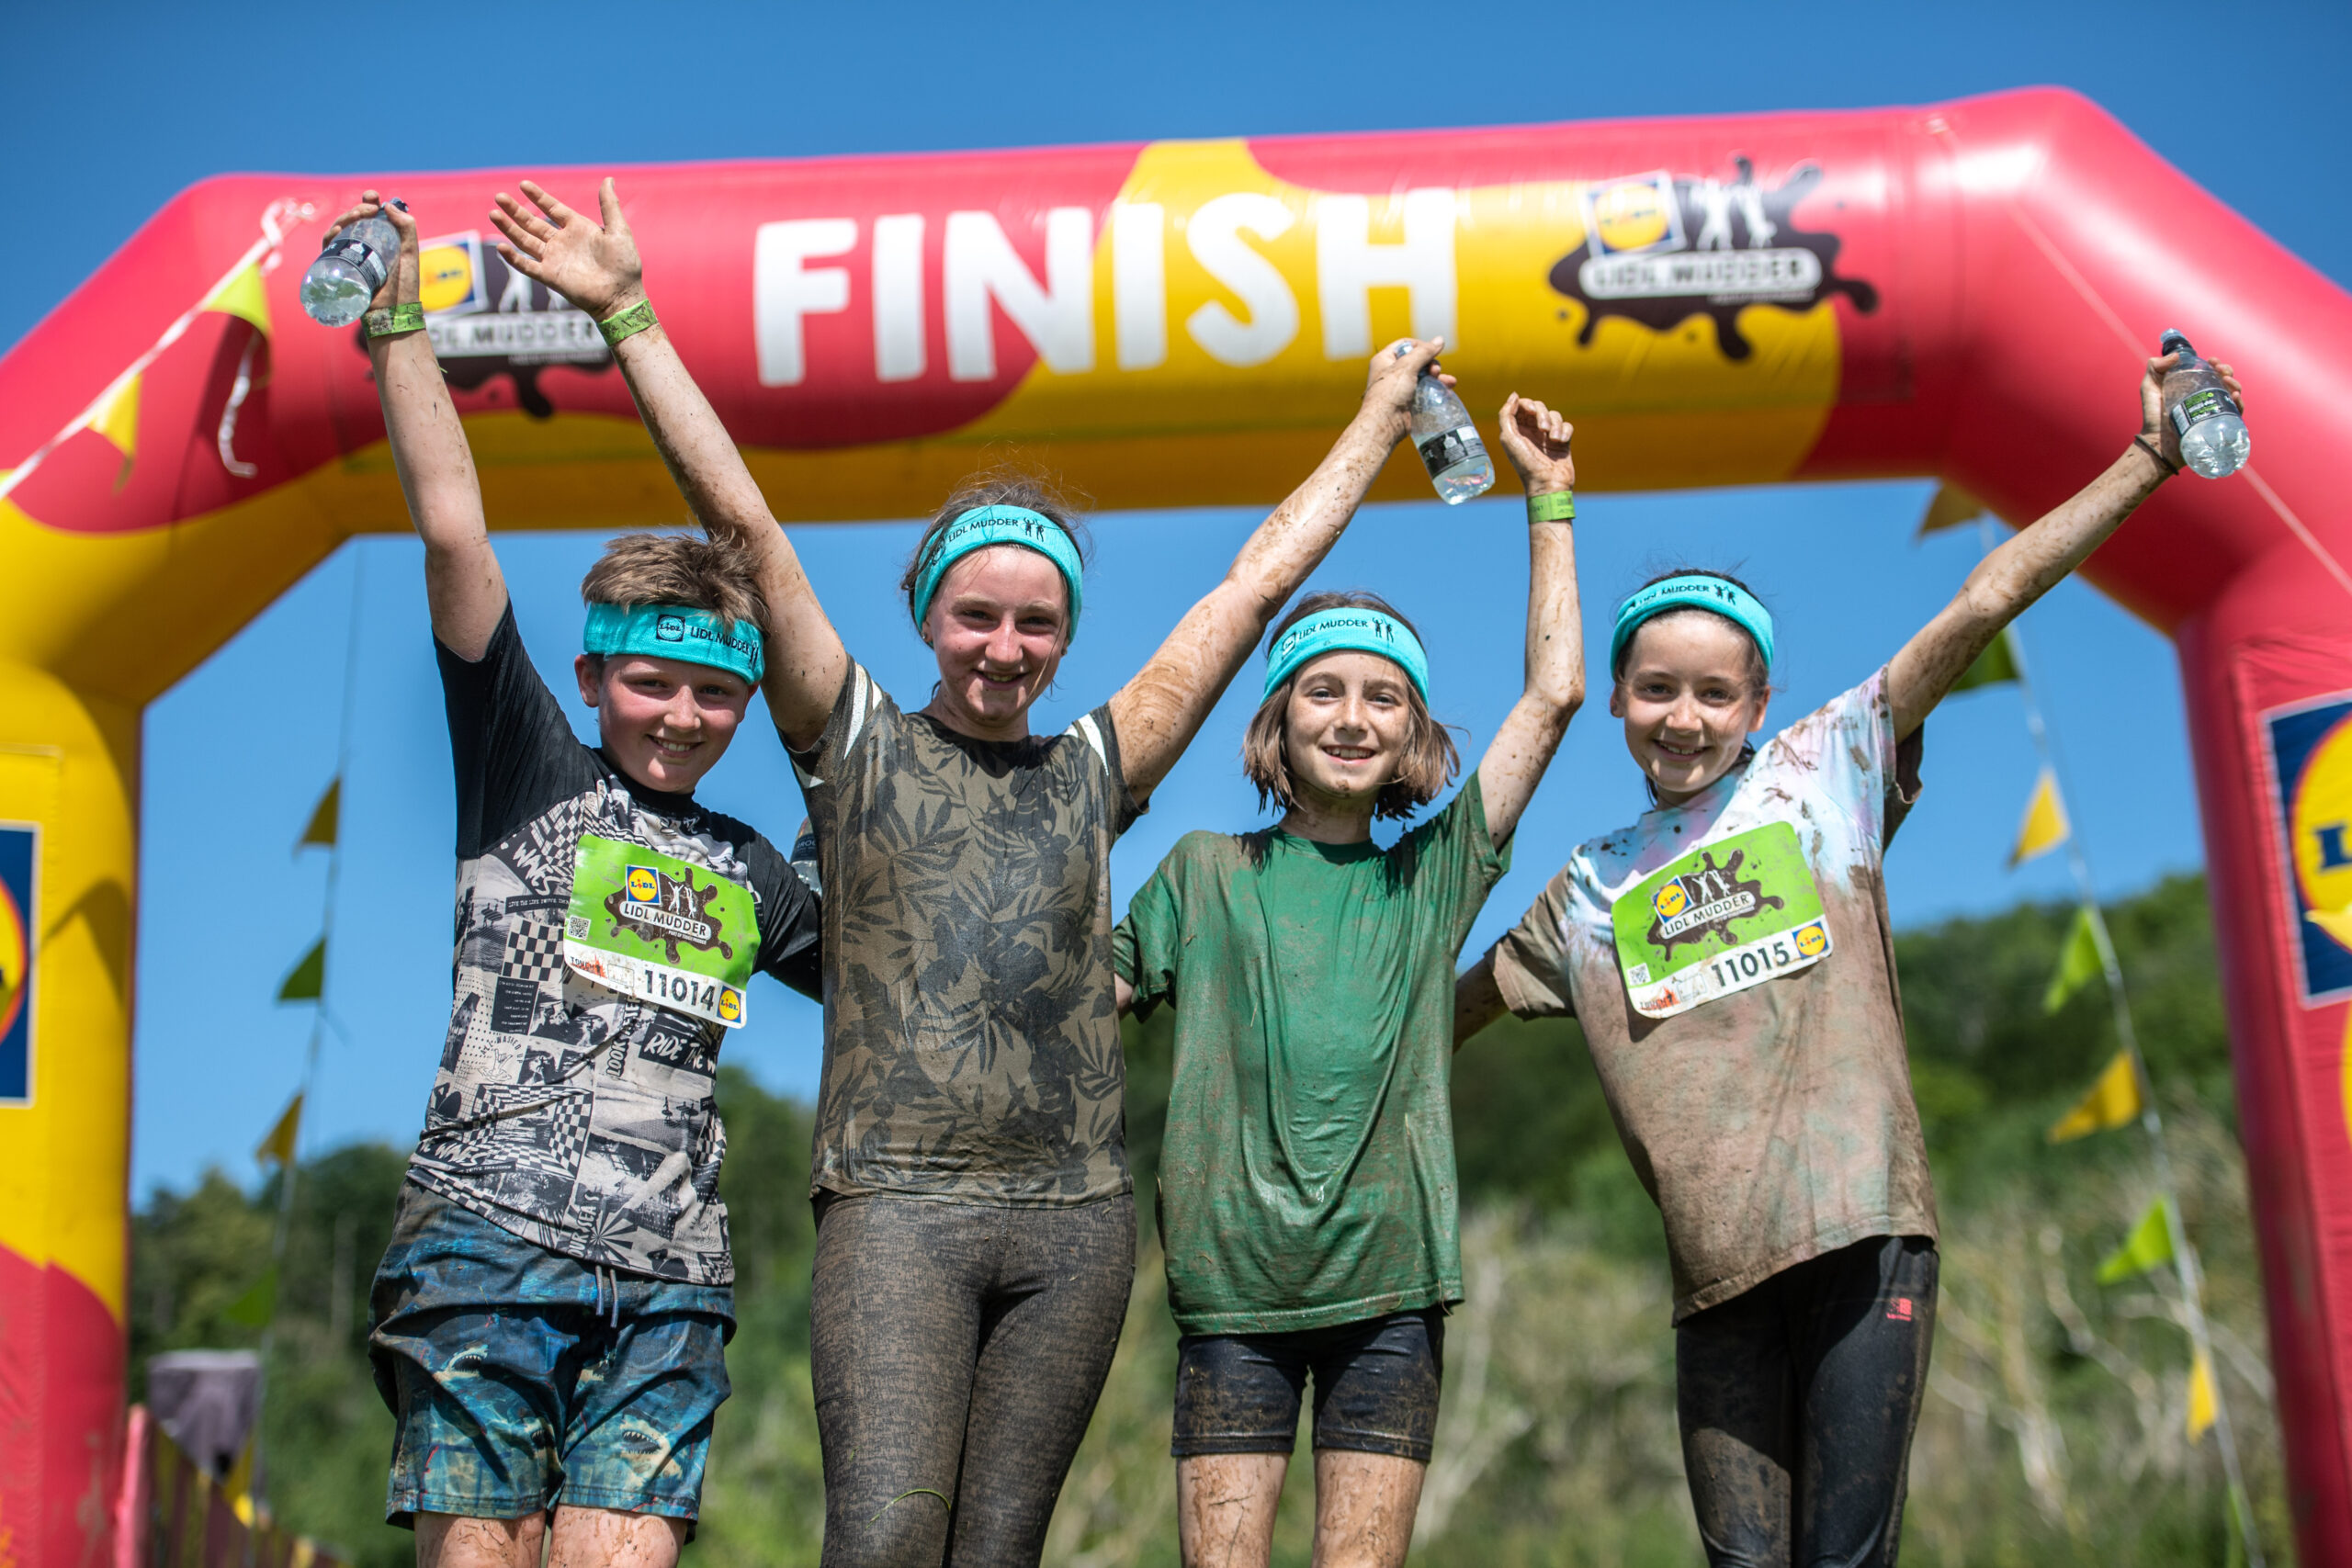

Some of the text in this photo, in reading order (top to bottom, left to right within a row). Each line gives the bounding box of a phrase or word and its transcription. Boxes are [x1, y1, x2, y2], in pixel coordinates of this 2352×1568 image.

[754, 187, 1457, 387] FINISH
[948, 518, 1018, 543] LIDL MUDDER
[1662, 584, 1710, 595] MUDDER
[691, 626, 750, 653] LIDL MUDDER
[1319, 619, 1368, 631] MUDDER
[624, 902, 707, 937] LIDL MUDDER
[1664, 919, 1690, 936] LIDL
[1693, 894, 1749, 923] MUDDER
[1712, 942, 1791, 987] 11015
[645, 969, 716, 1011] 11014
[606, 1038, 628, 1077] LOOK
[644, 1032, 687, 1061] RIDE
[568, 1232, 588, 1258] OUR
